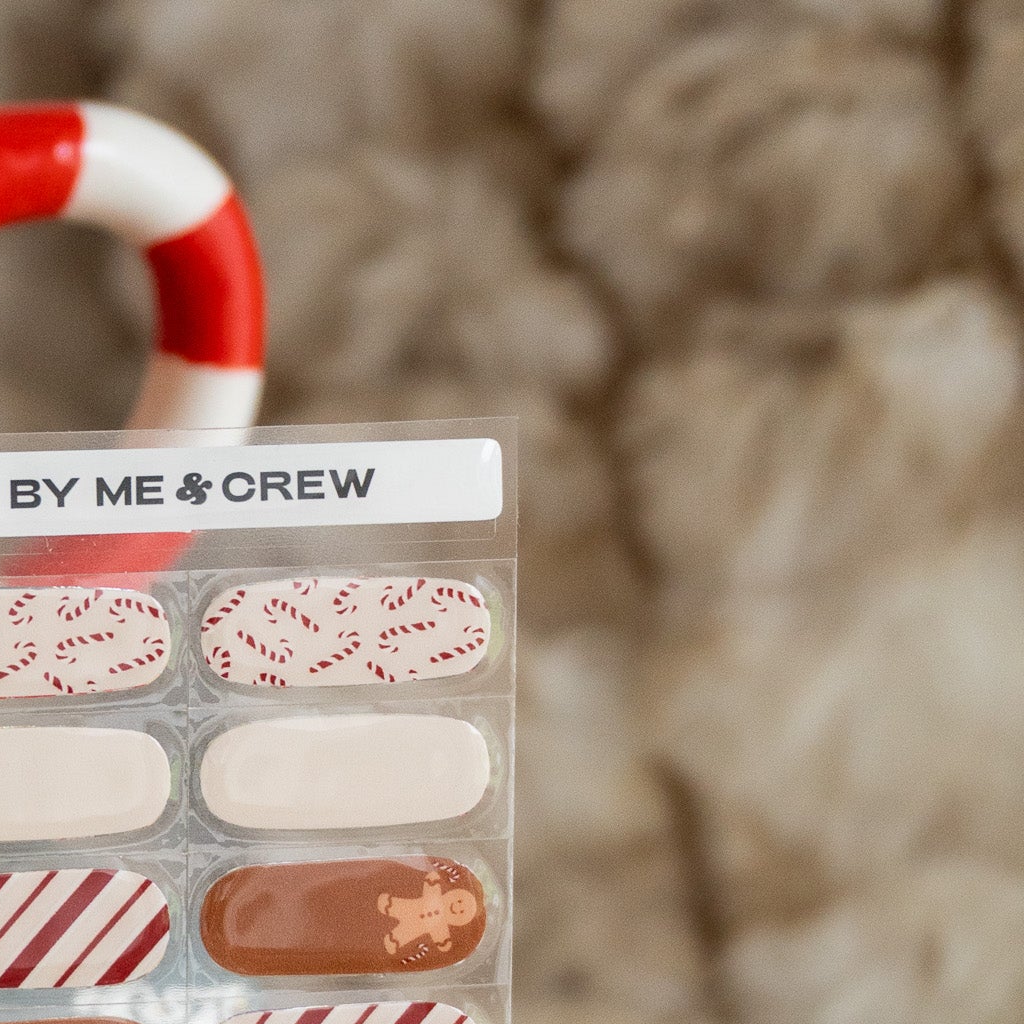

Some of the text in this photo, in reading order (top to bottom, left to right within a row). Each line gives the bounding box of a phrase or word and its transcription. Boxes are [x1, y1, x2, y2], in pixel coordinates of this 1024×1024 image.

[9, 468, 376, 510] BY ME & CREW
